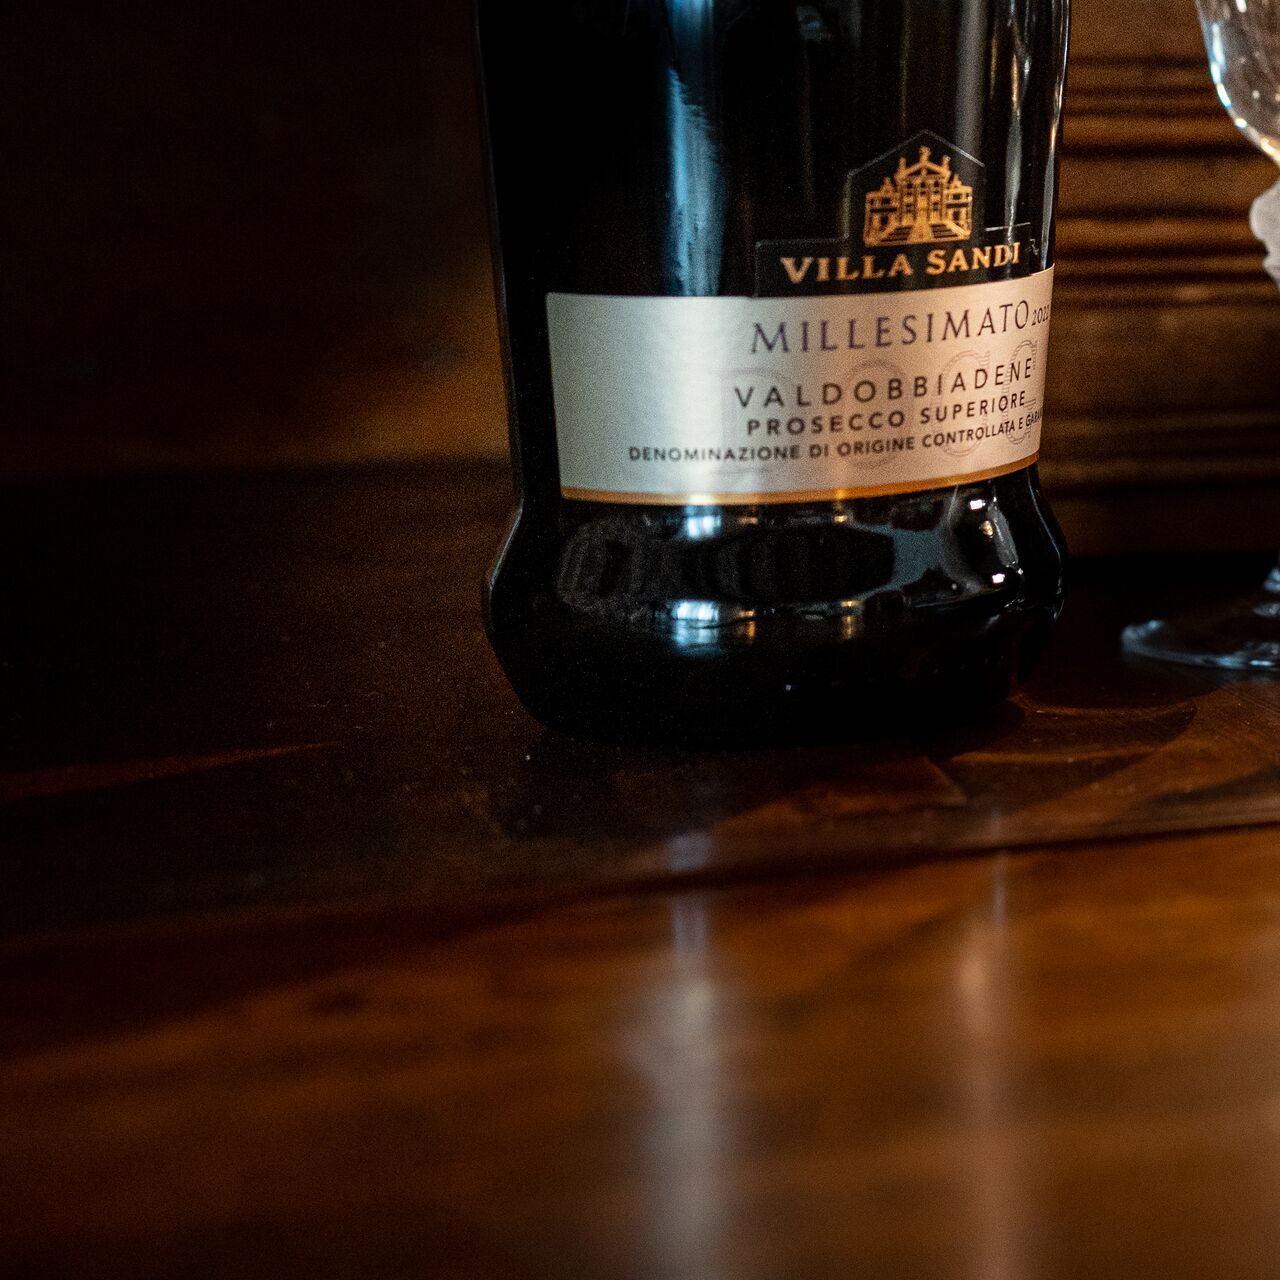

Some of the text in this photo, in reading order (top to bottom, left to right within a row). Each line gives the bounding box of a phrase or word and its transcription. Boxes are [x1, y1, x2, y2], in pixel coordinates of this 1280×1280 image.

[780, 242, 1020, 284] VILLA SANDI
[751, 300, 1029, 353] MILLESIMATO
[734, 357, 1033, 408] VALDOBBIADENE
[747, 390, 1026, 437] PROSECCO SUPERIORE
[628, 443, 801, 462] DENOMINAZIONE
[809, 445, 829, 459] DI
[837, 436, 915, 458] ORIGINE
[923, 420, 1015, 448] CONTROLLATA
[1018, 417, 1024, 430] E
